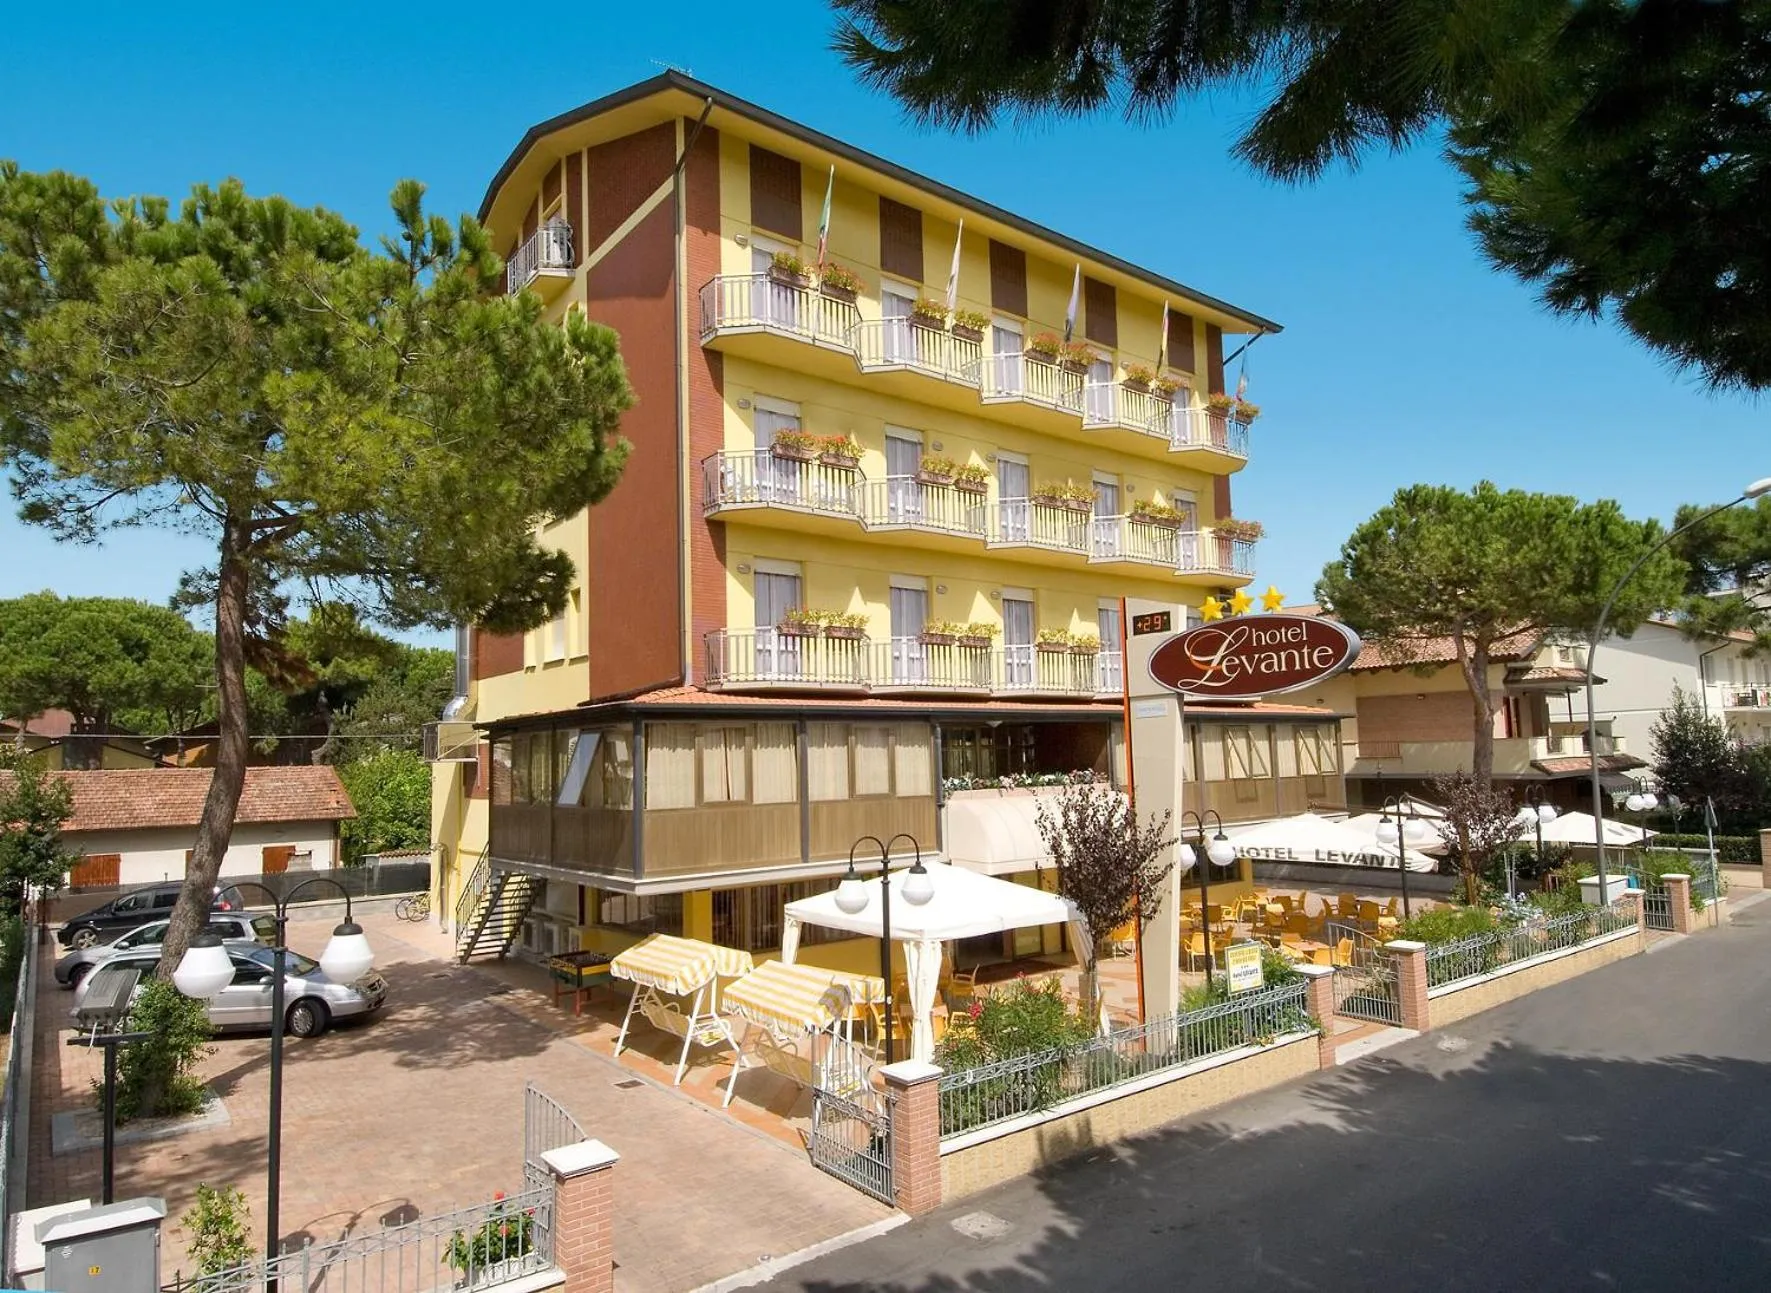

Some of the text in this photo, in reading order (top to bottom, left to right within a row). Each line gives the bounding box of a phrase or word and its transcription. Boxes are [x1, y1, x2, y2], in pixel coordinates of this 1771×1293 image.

[1252, 622, 1307, 646] hotel
[1178, 626, 1334, 690] Levante
[1232, 846, 1413, 868] HOTEL LEVANTE
